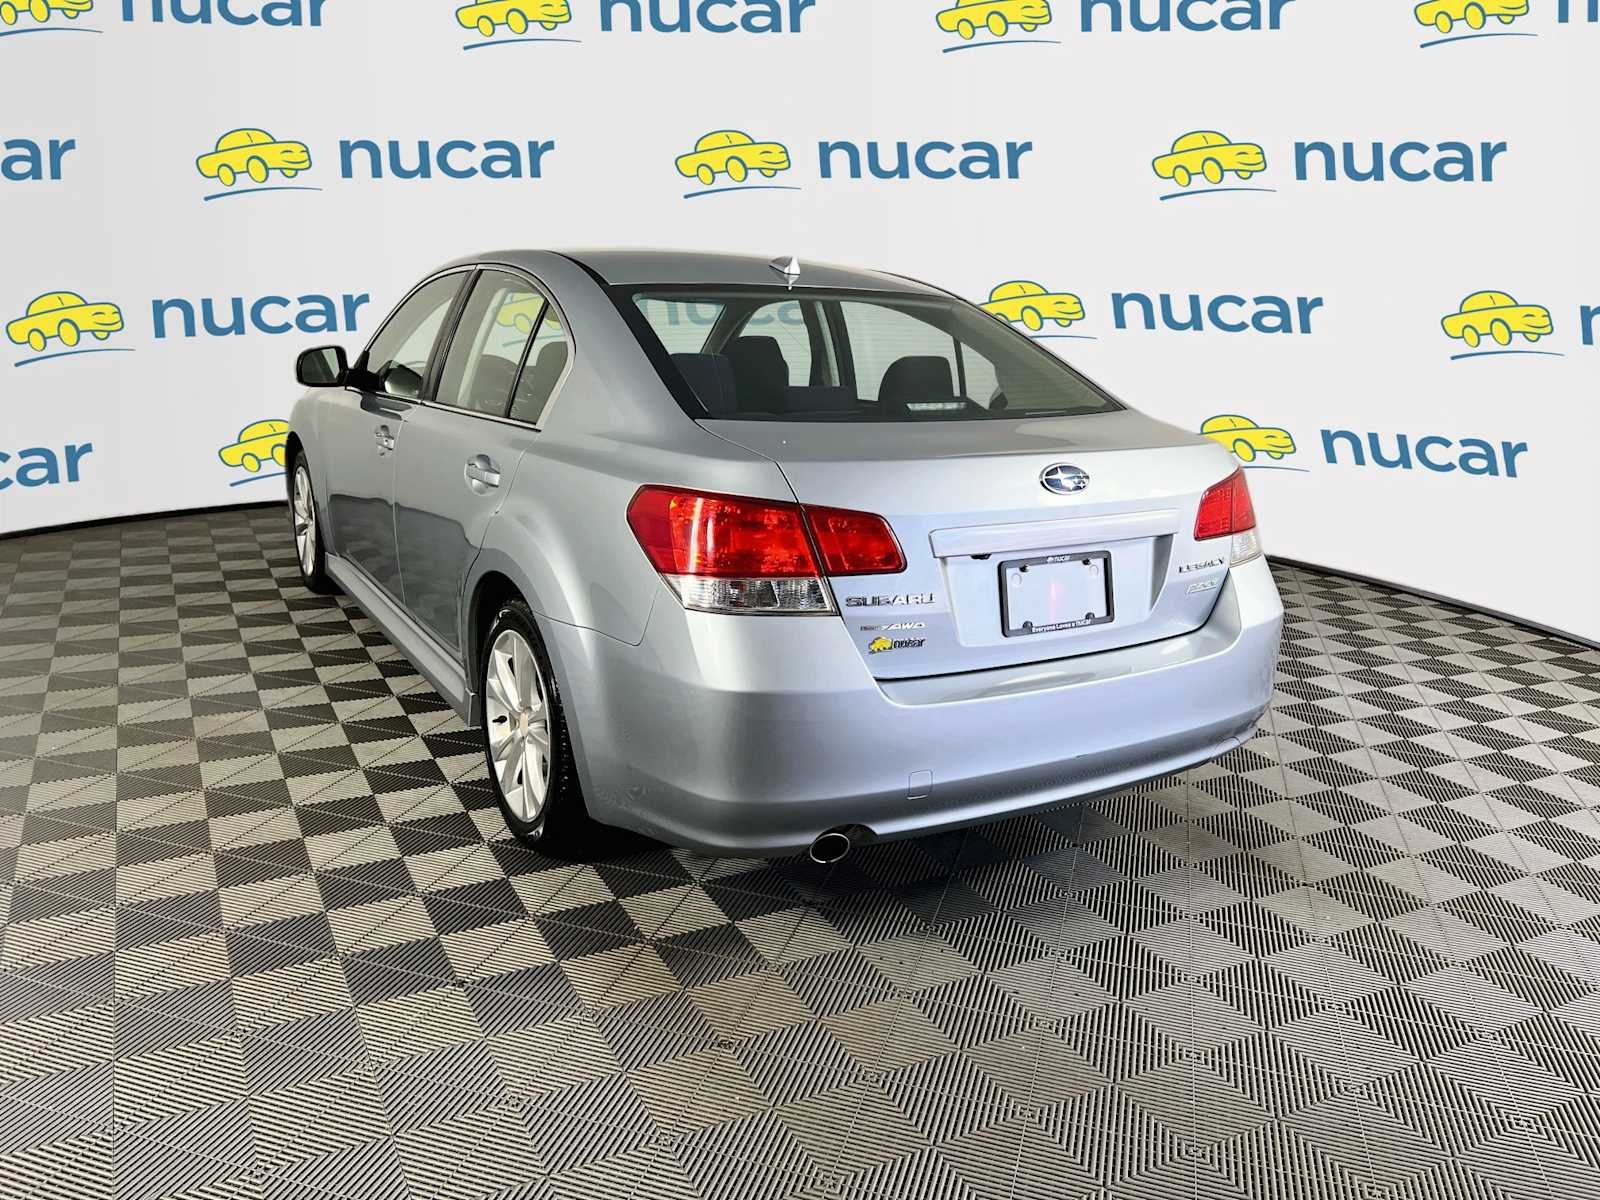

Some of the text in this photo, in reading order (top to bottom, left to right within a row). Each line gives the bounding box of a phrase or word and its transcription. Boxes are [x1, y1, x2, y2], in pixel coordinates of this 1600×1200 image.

[600, 0, 816, 33] nucar
[1080, 0, 1292, 32] nucar
[339, 139, 555, 181] nucar
[818, 140, 1033, 181] nucar
[1294, 140, 1507, 182] nucar
[152, 293, 370, 340] nucar
[1111, 291, 1324, 334] nucar
[1320, 428, 1529, 479] nucar
[845, 592, 935, 608] SUBARU
[892, 638, 927, 650] nucar
